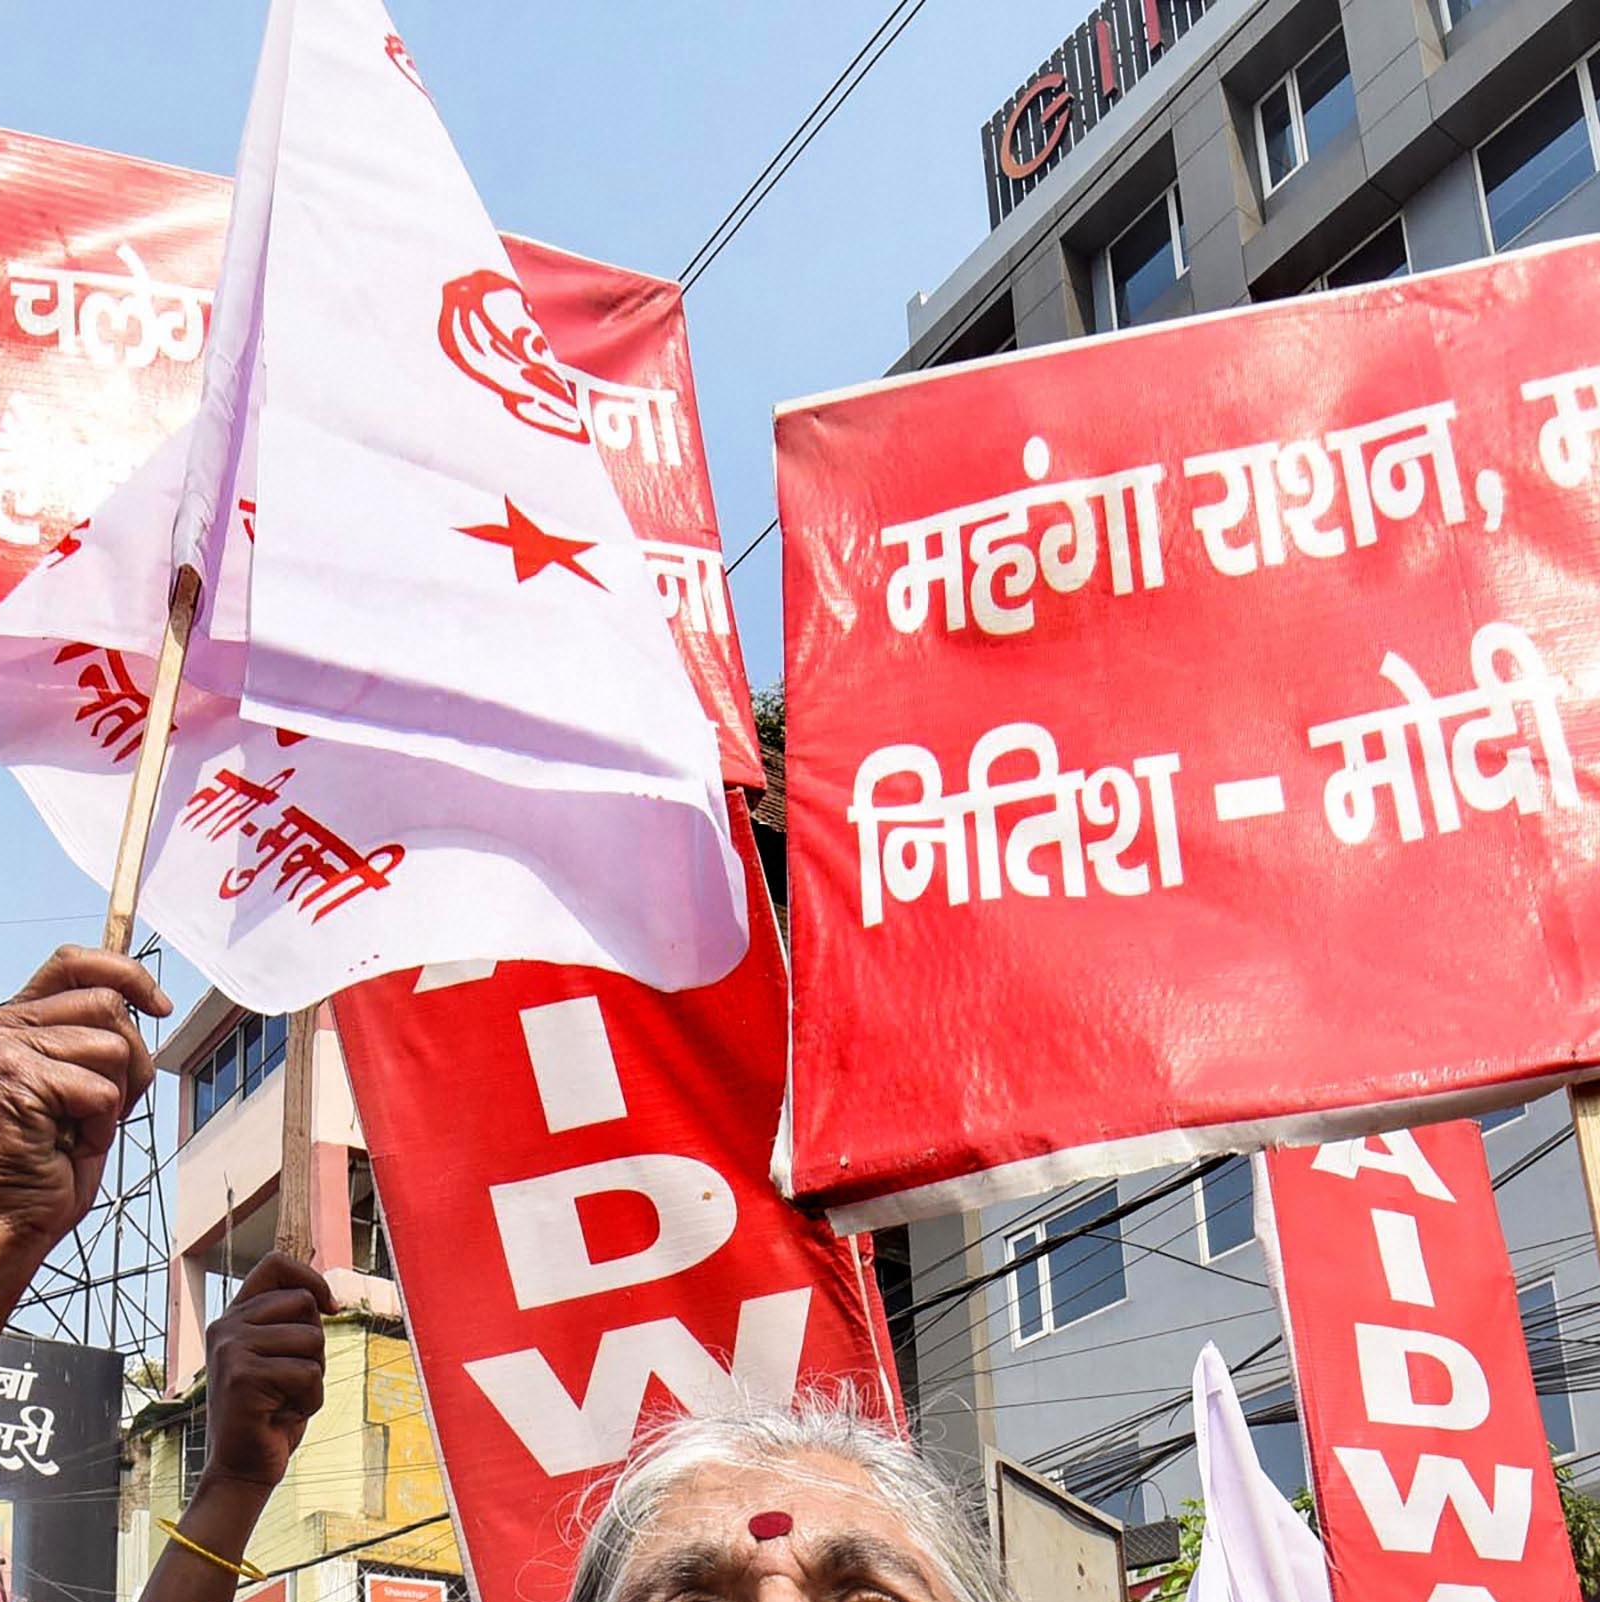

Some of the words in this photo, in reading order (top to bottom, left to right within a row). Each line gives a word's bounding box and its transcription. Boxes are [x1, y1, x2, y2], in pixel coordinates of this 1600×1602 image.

[1000, 0, 1168, 179] GI
[7, 243, 216, 369] चलेग
[880, 436, 1167, 636] महंगा
[1183, 400, 1503, 577] राशन,
[847, 722, 1184, 928] नितिश
[1308, 622, 1580, 844] मोदी
